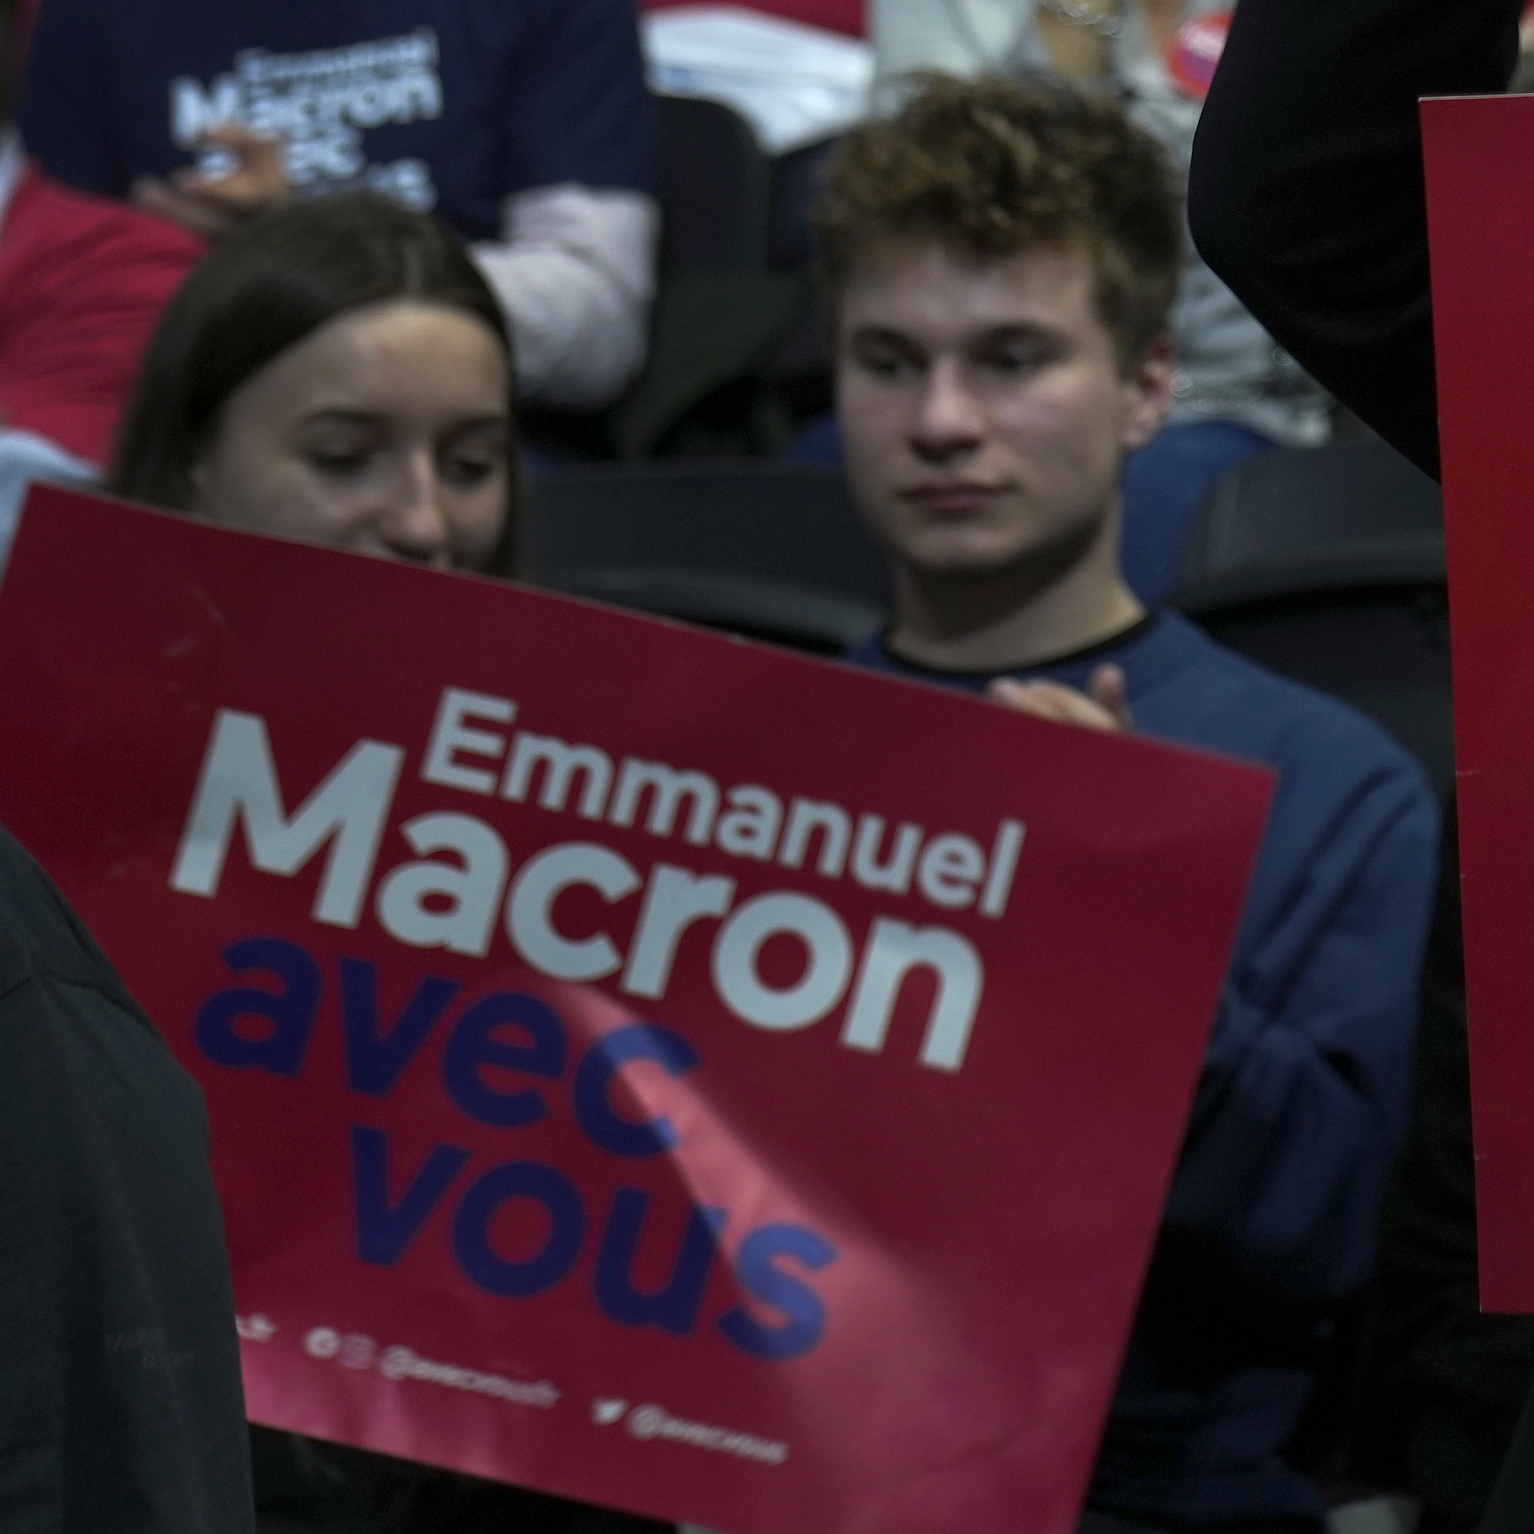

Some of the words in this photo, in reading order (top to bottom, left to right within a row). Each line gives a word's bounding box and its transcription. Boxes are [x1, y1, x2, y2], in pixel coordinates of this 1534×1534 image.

[171, 710, 984, 1072] Macron
[423, 688, 1024, 916] Emmanuel
[195, 938, 700, 1158] avec
[350, 1126, 837, 1360] vous
